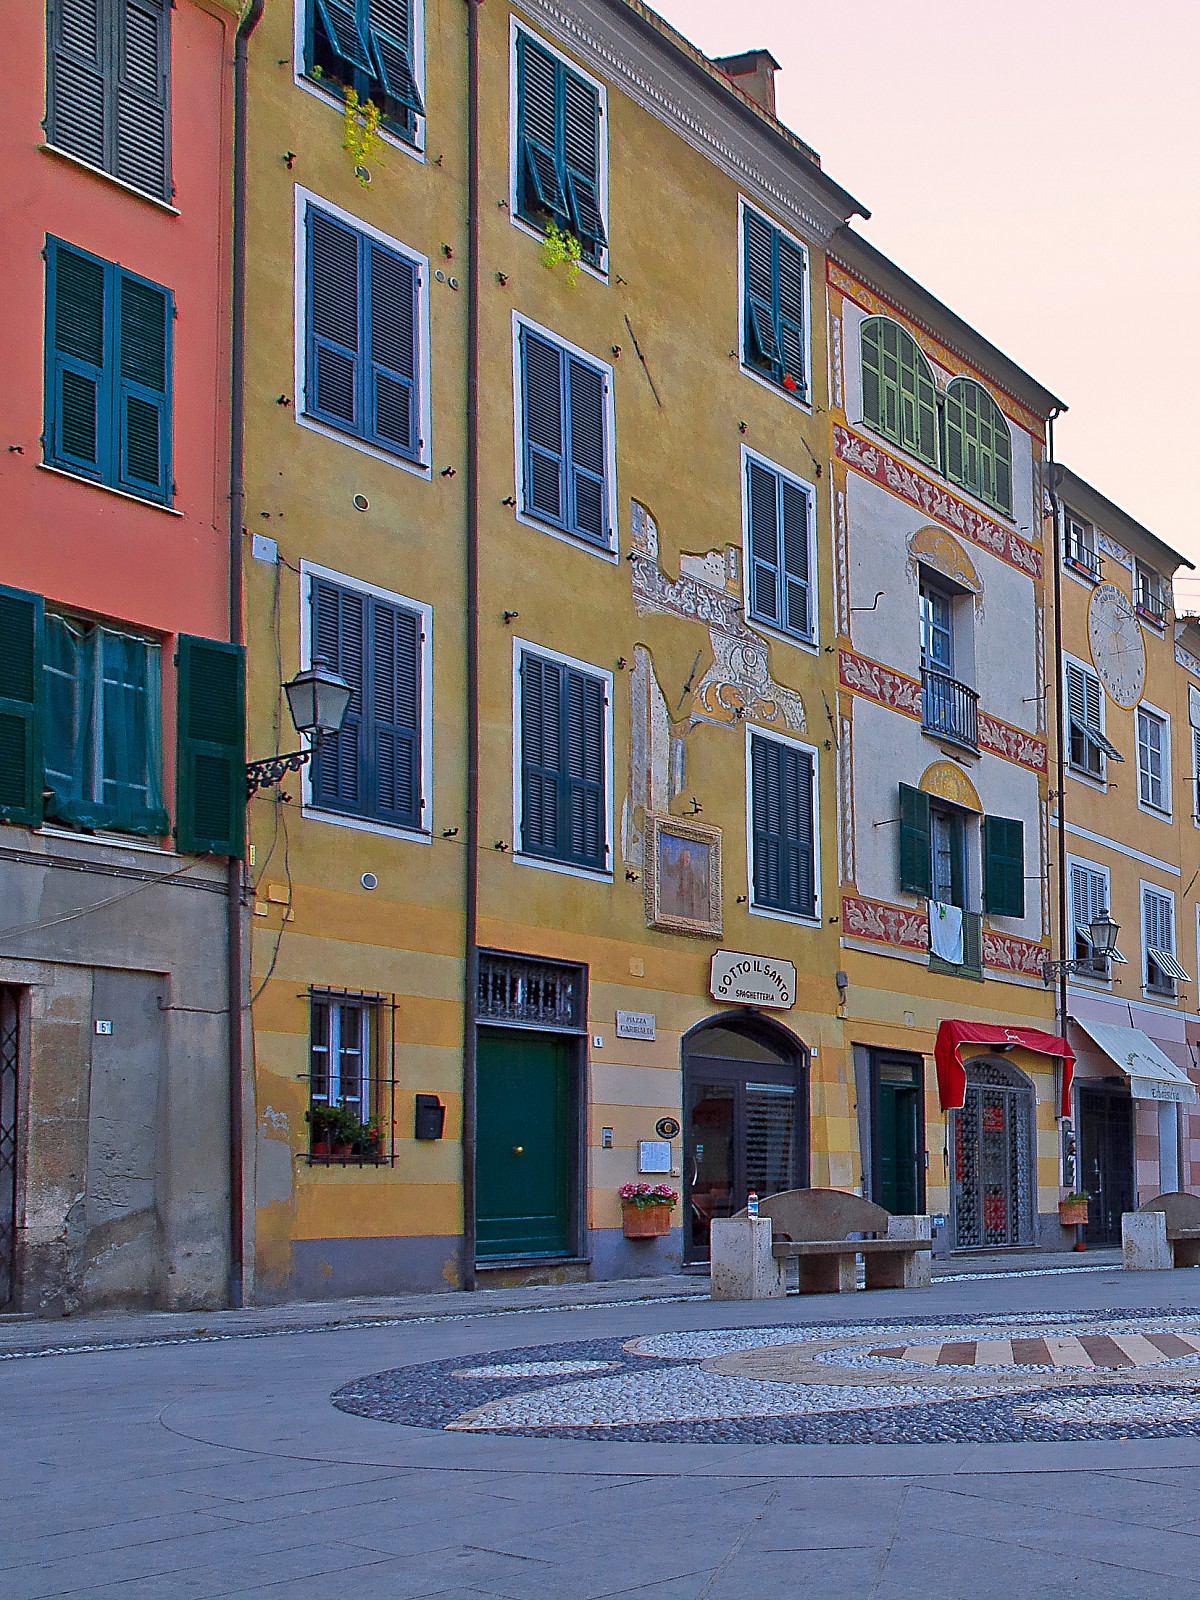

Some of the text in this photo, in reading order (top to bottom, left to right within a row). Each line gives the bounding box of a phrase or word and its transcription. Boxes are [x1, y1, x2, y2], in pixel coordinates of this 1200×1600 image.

[718, 960, 789, 1002] SOTTO IL SANTO
[735, 989, 775, 1002] SPAGHETTERIA
[626, 1016, 647, 1025] PIAZZA
